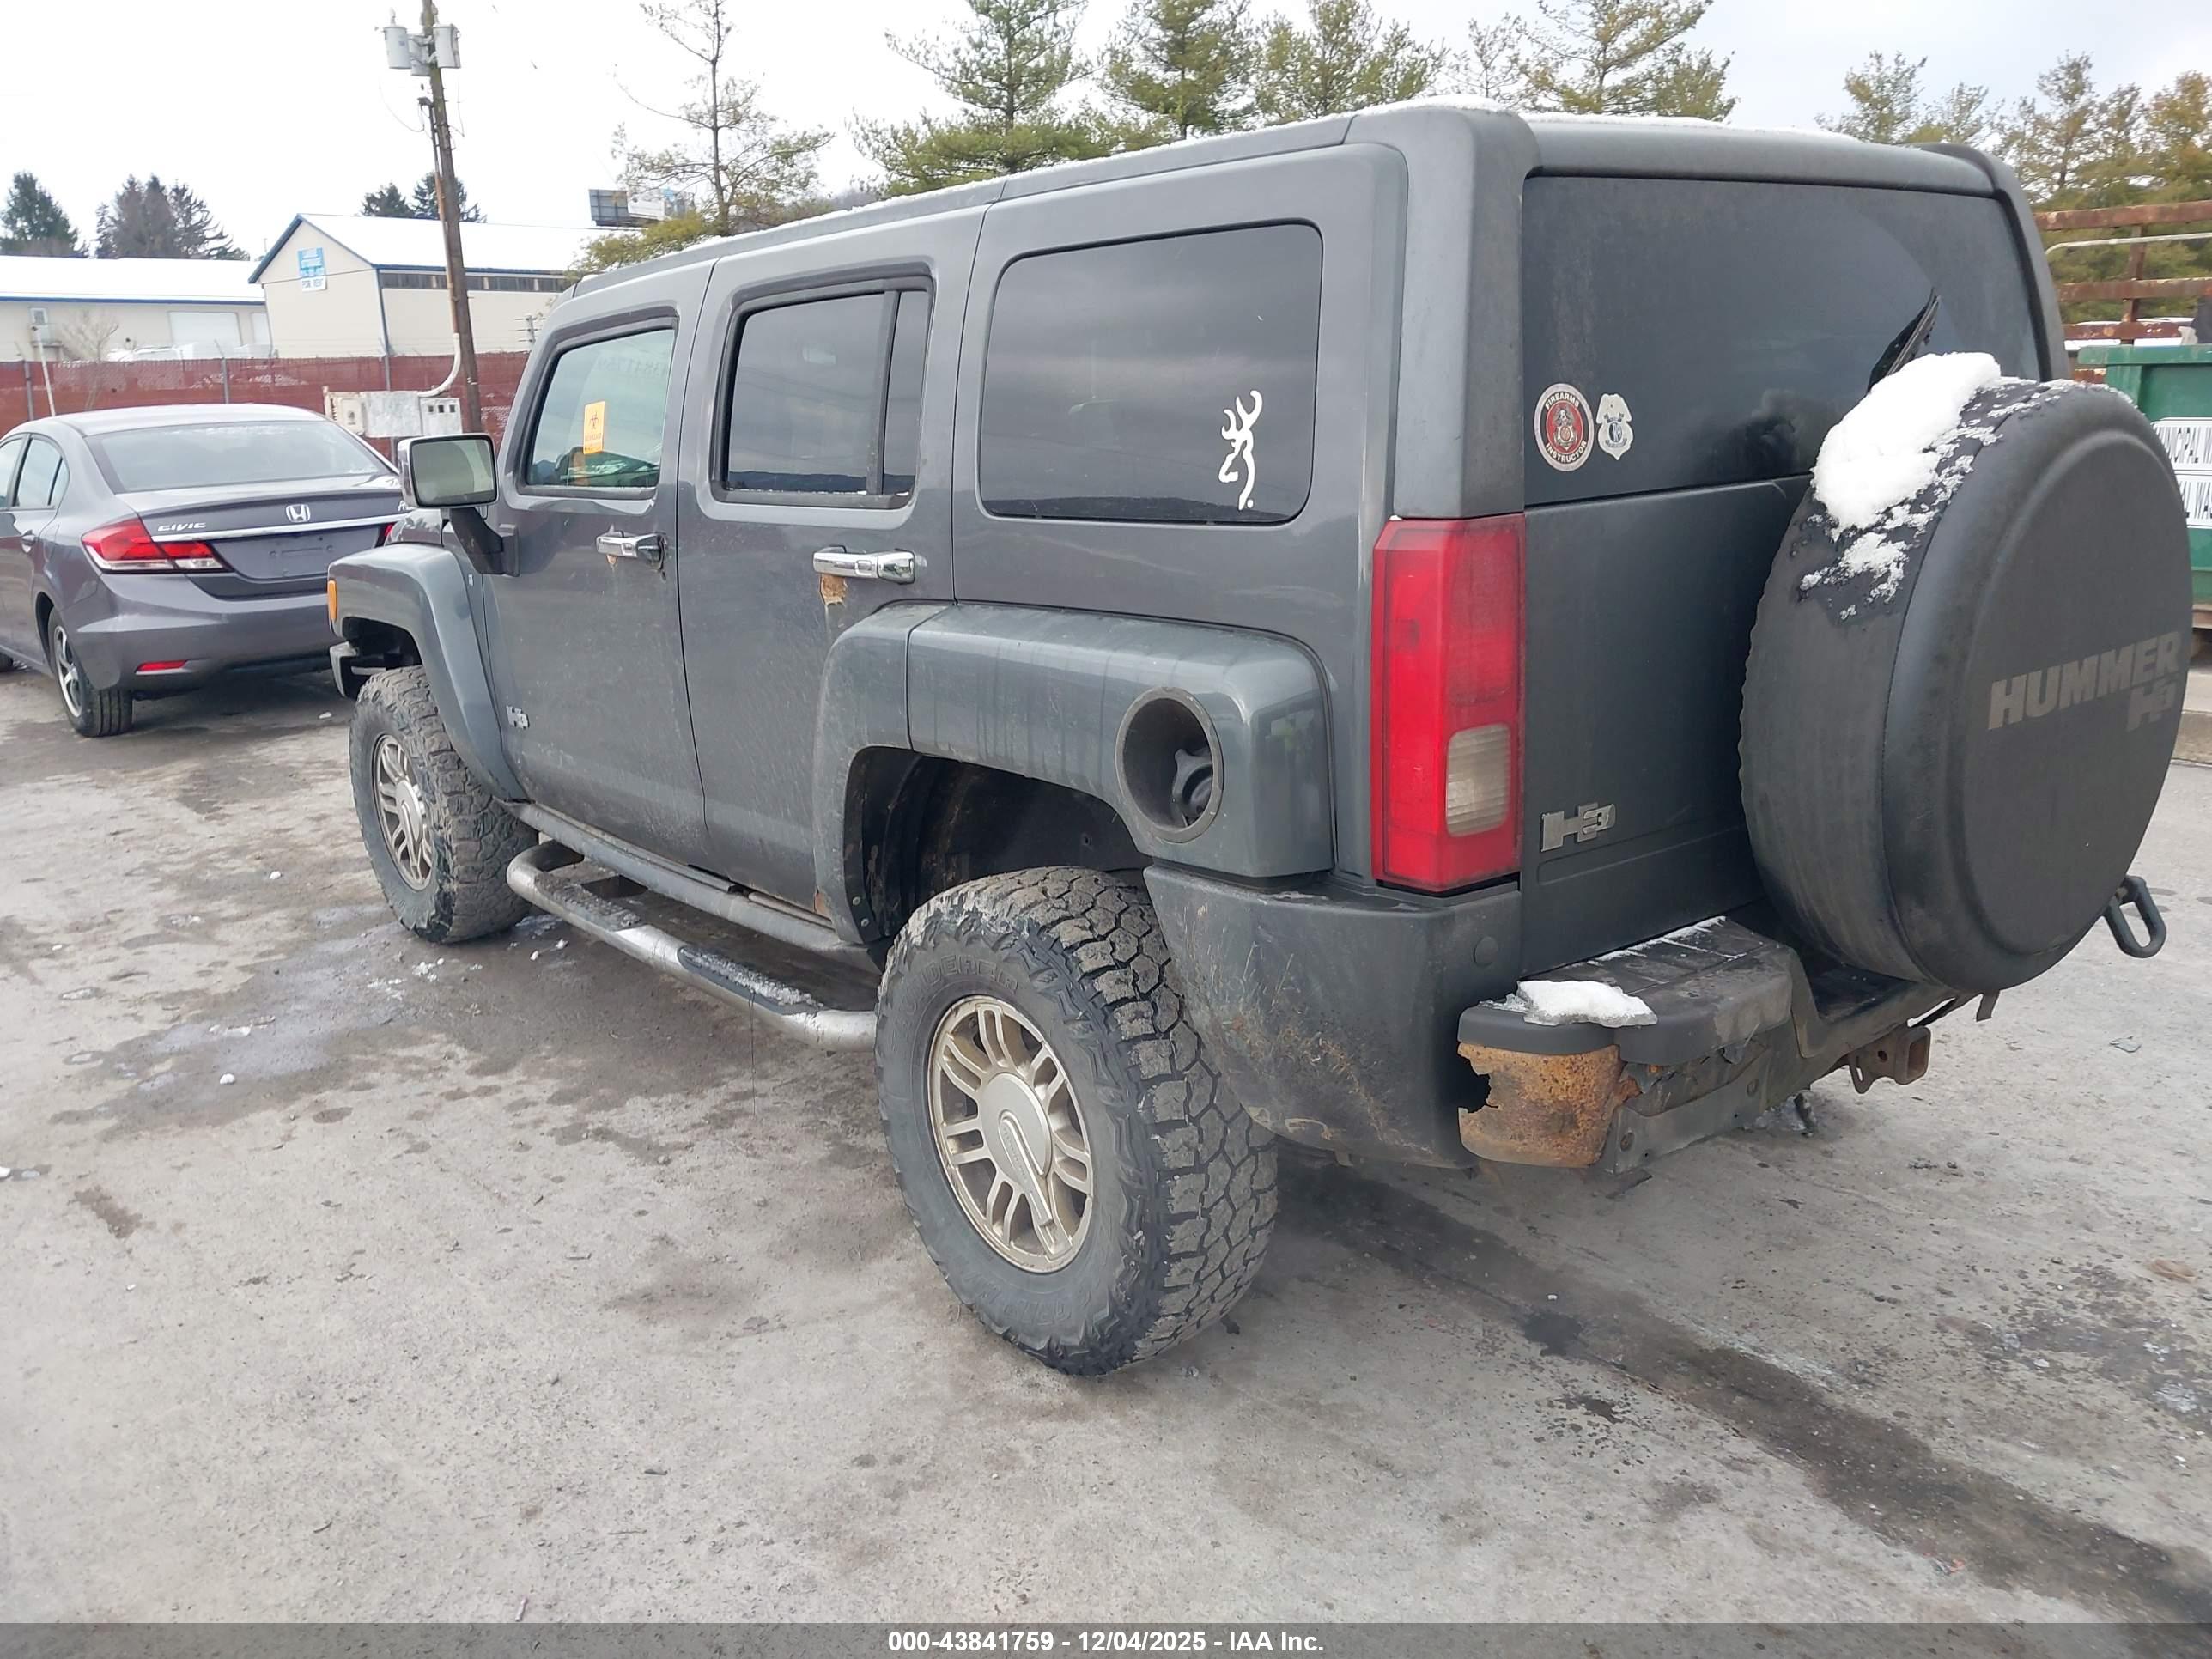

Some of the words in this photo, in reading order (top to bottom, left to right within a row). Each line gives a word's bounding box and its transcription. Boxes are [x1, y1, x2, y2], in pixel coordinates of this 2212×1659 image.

[1546, 392, 1579, 410] FIREARMS
[1545, 440, 1587, 463] INSTRUCTOR
[157, 522, 207, 532] CIVIC
[1988, 631, 2180, 730] HUMMER
[1540, 802, 1616, 853] H3
